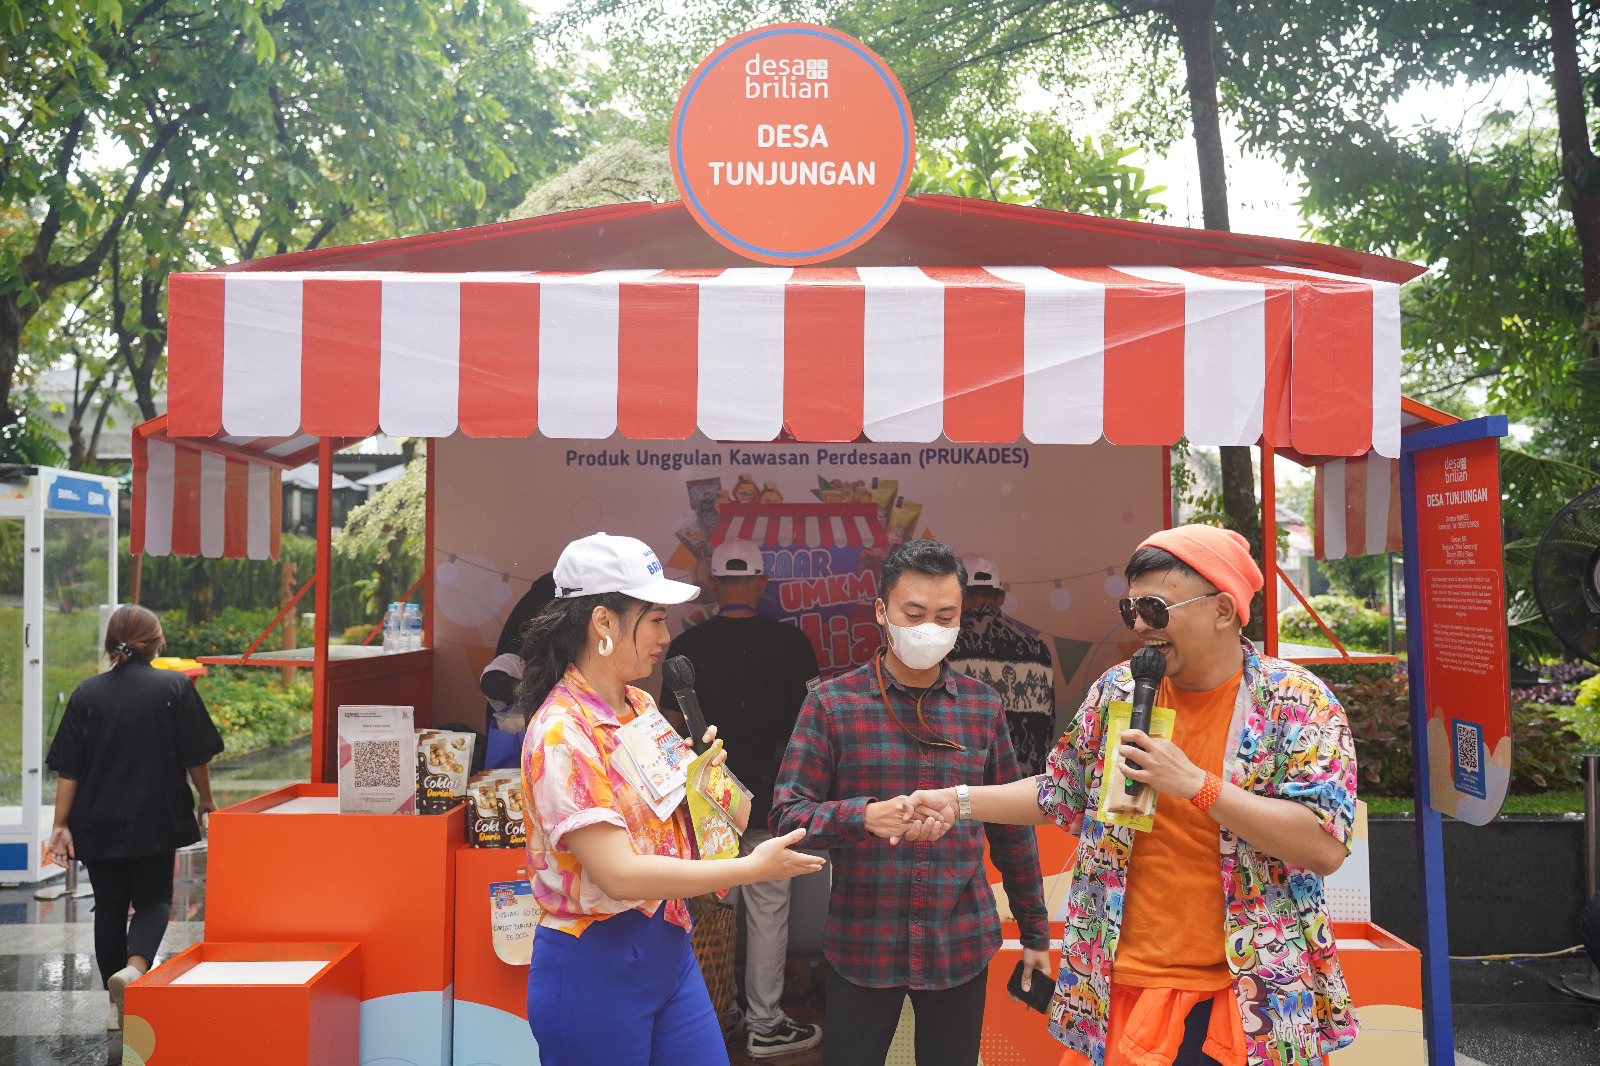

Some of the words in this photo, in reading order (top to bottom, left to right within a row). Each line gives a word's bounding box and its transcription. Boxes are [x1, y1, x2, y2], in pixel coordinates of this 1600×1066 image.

[745, 53, 805, 76] desa
[745, 76, 829, 98] brilian
[757, 124, 829, 148] DESA
[708, 161, 876, 186] TUNJUNGAN
[565, 449, 630, 467] Produk
[636, 448, 722, 471] Unggulan
[729, 448, 810, 465] Kawasan
[817, 448, 911, 466] Perdesaan
[918, 446, 1030, 469] (PRUKADES)
[1444, 457, 1461, 470] desa
[1444, 469, 1468, 484] brilian
[1426, 493, 1444, 507] DESA
[1445, 487, 1488, 505] TUNJUNGAN
[779, 569, 878, 612] UMKM
[423, 775, 461, 790] Coklat
[426, 788, 455, 798] Durian
